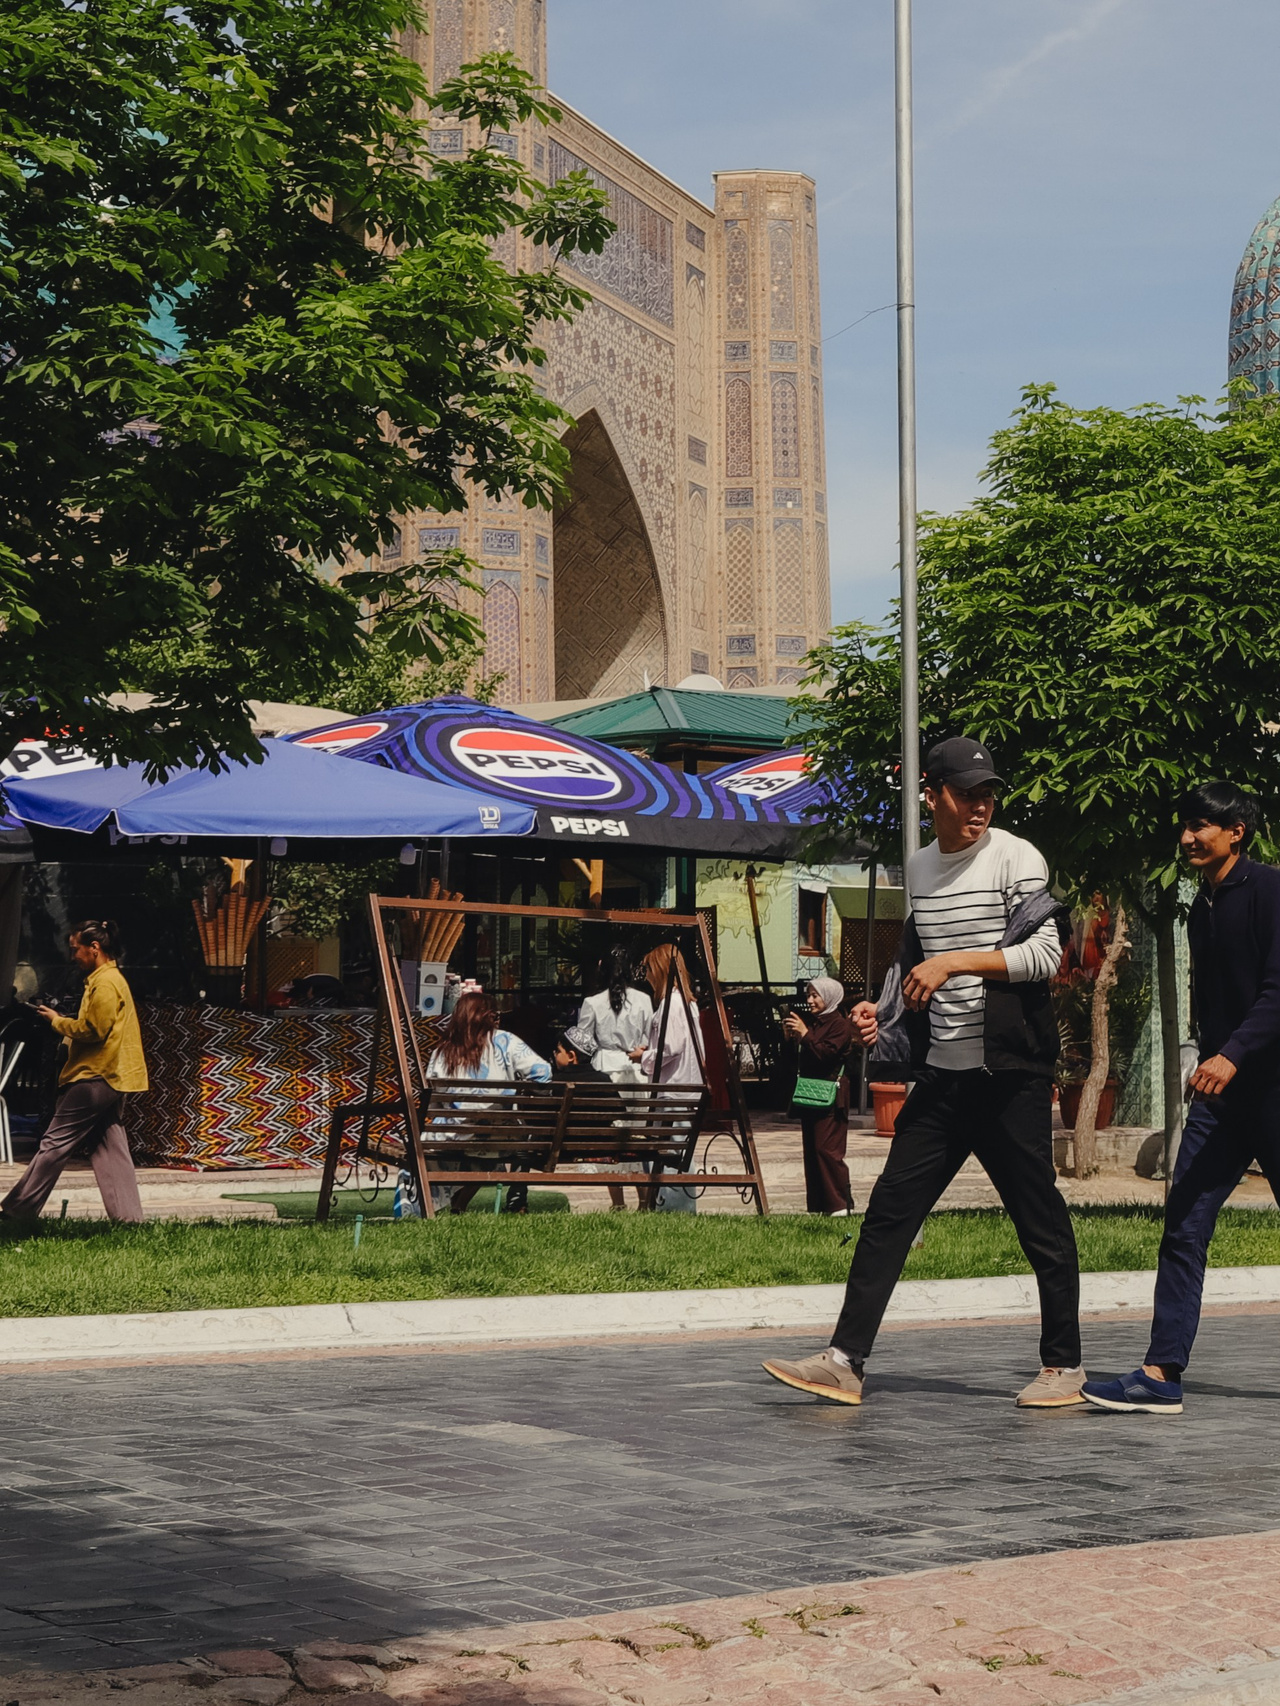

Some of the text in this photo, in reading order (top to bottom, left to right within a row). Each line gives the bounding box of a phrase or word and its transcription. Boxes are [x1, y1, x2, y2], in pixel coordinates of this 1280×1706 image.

[7, 743, 86, 773] PE
[465, 753, 607, 776] PEPSI
[550, 816, 630, 837] PEPSI
